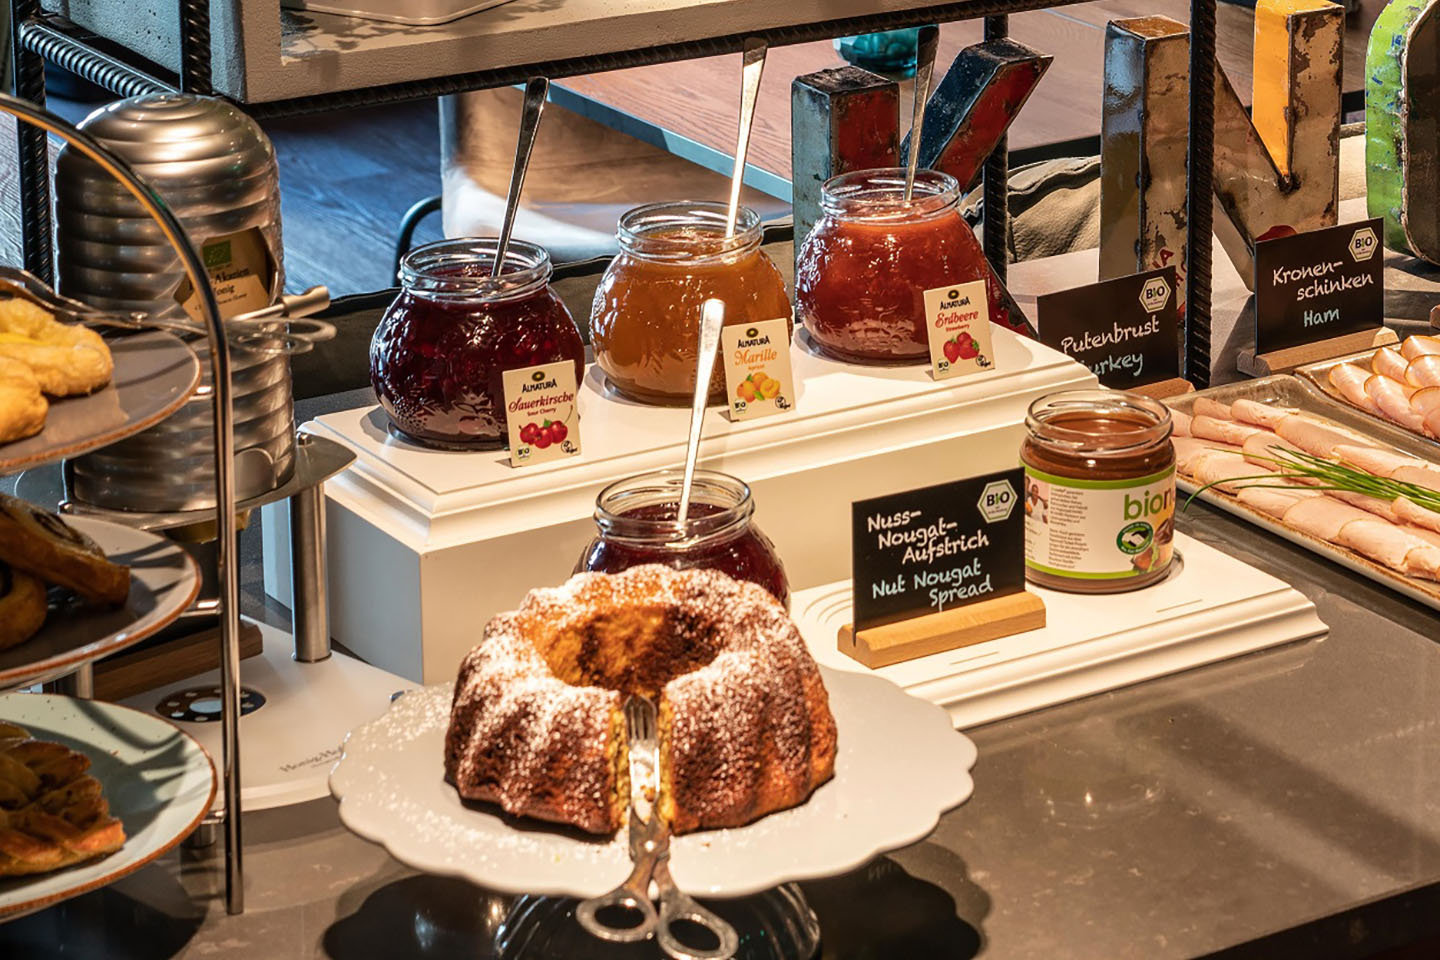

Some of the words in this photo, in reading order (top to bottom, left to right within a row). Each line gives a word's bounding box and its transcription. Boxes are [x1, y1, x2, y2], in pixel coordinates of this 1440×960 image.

[1272, 261, 1343, 287] Kronen-
[1296, 273, 1374, 301] schinken
[935, 311, 979, 328] Erdbeere
[1303, 308, 1340, 328] Ham
[1061, 314, 1160, 355] Putenbrust
[734, 348, 777, 366] Marille
[1084, 353, 1144, 377] urkey
[508, 391, 574, 413] Sauerkirsche
[867, 509, 922, 533] Nuss-
[878, 517, 958, 550] Nougat-
[902, 529, 989, 565] Aufstrich
[872, 574, 906, 600] Nut
[914, 557, 982, 590] Nougat
[929, 574, 994, 612] Spread
